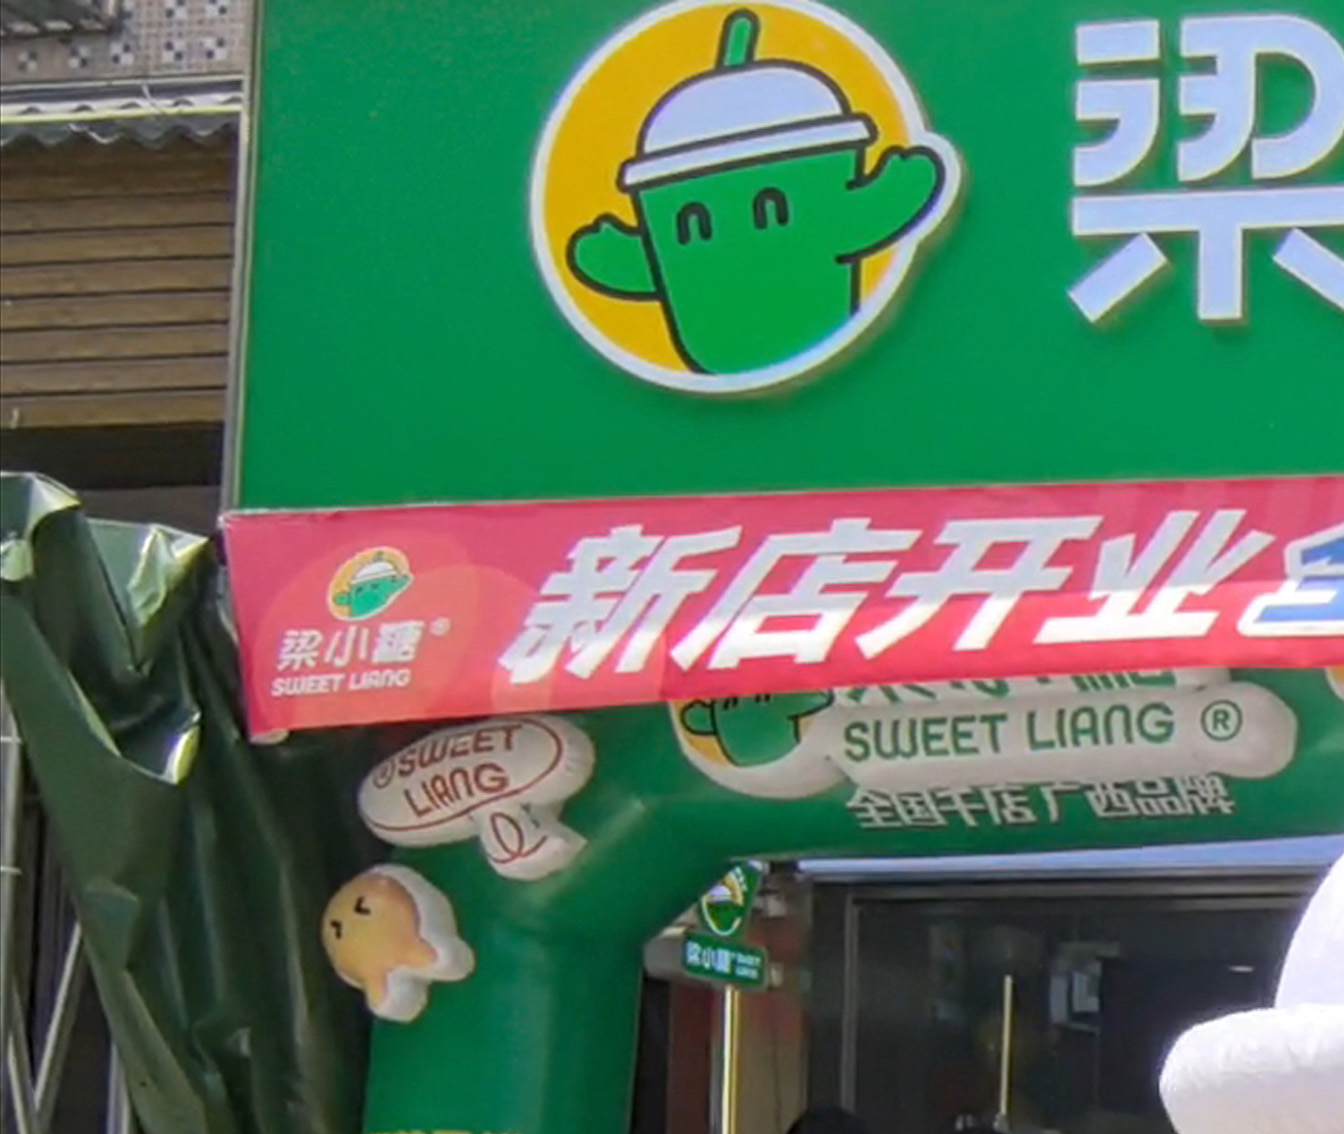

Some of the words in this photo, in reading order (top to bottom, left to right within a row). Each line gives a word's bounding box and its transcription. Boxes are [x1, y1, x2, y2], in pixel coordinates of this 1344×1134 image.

[277, 621, 423, 670] 梁小糖
[271, 675, 344, 697] SWEET
[349, 669, 410, 691] LIANG
[399, 723, 524, 777] SWEET
[844, 712, 1007, 762] SWEET
[1026, 702, 1174, 751] LIANG
[404, 764, 510, 817] LIANG
